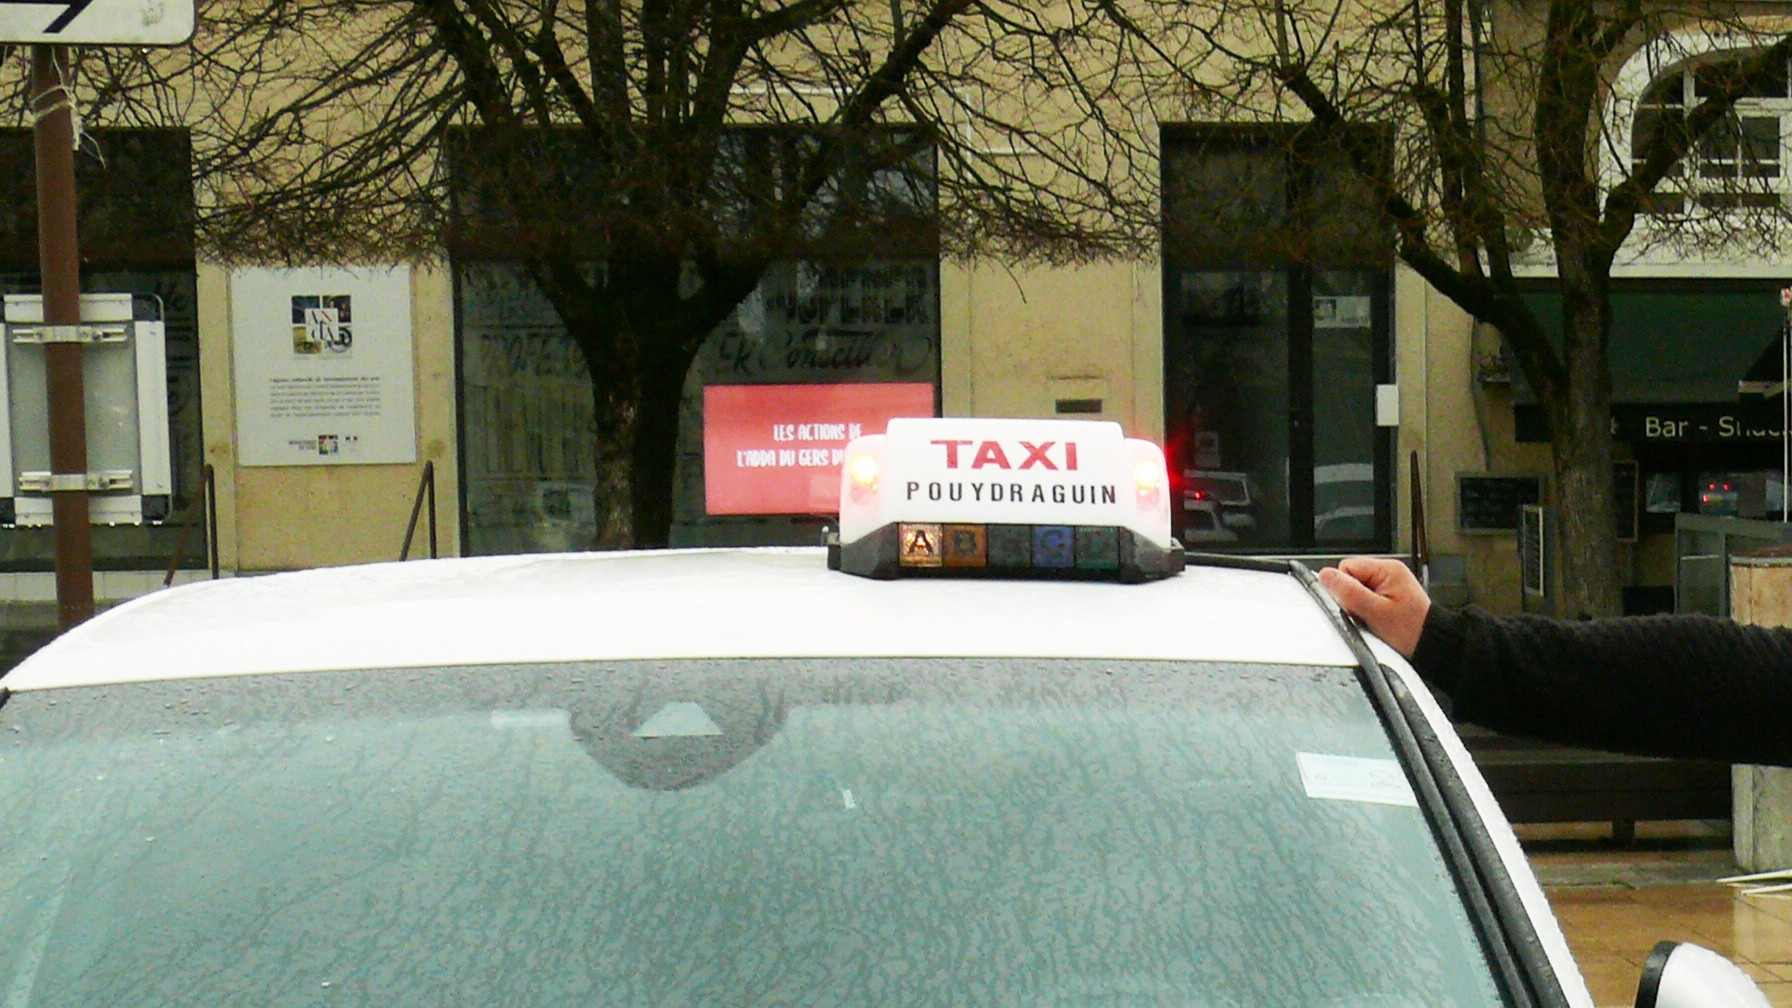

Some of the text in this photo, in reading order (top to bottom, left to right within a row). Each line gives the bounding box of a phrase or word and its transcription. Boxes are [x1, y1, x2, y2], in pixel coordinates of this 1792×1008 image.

[773, 424, 795, 441] LES
[798, 423, 846, 441] ACTIONS
[1645, 416, 1688, 438] Bar
[737, 450, 776, 467] L'ADDA
[779, 449, 796, 466] DU
[799, 448, 829, 466] GERS
[930, 439, 1079, 471] TAXI
[906, 481, 1117, 504] POUYDRAGUIN
[908, 529, 934, 554] A
[953, 529, 978, 555] B
